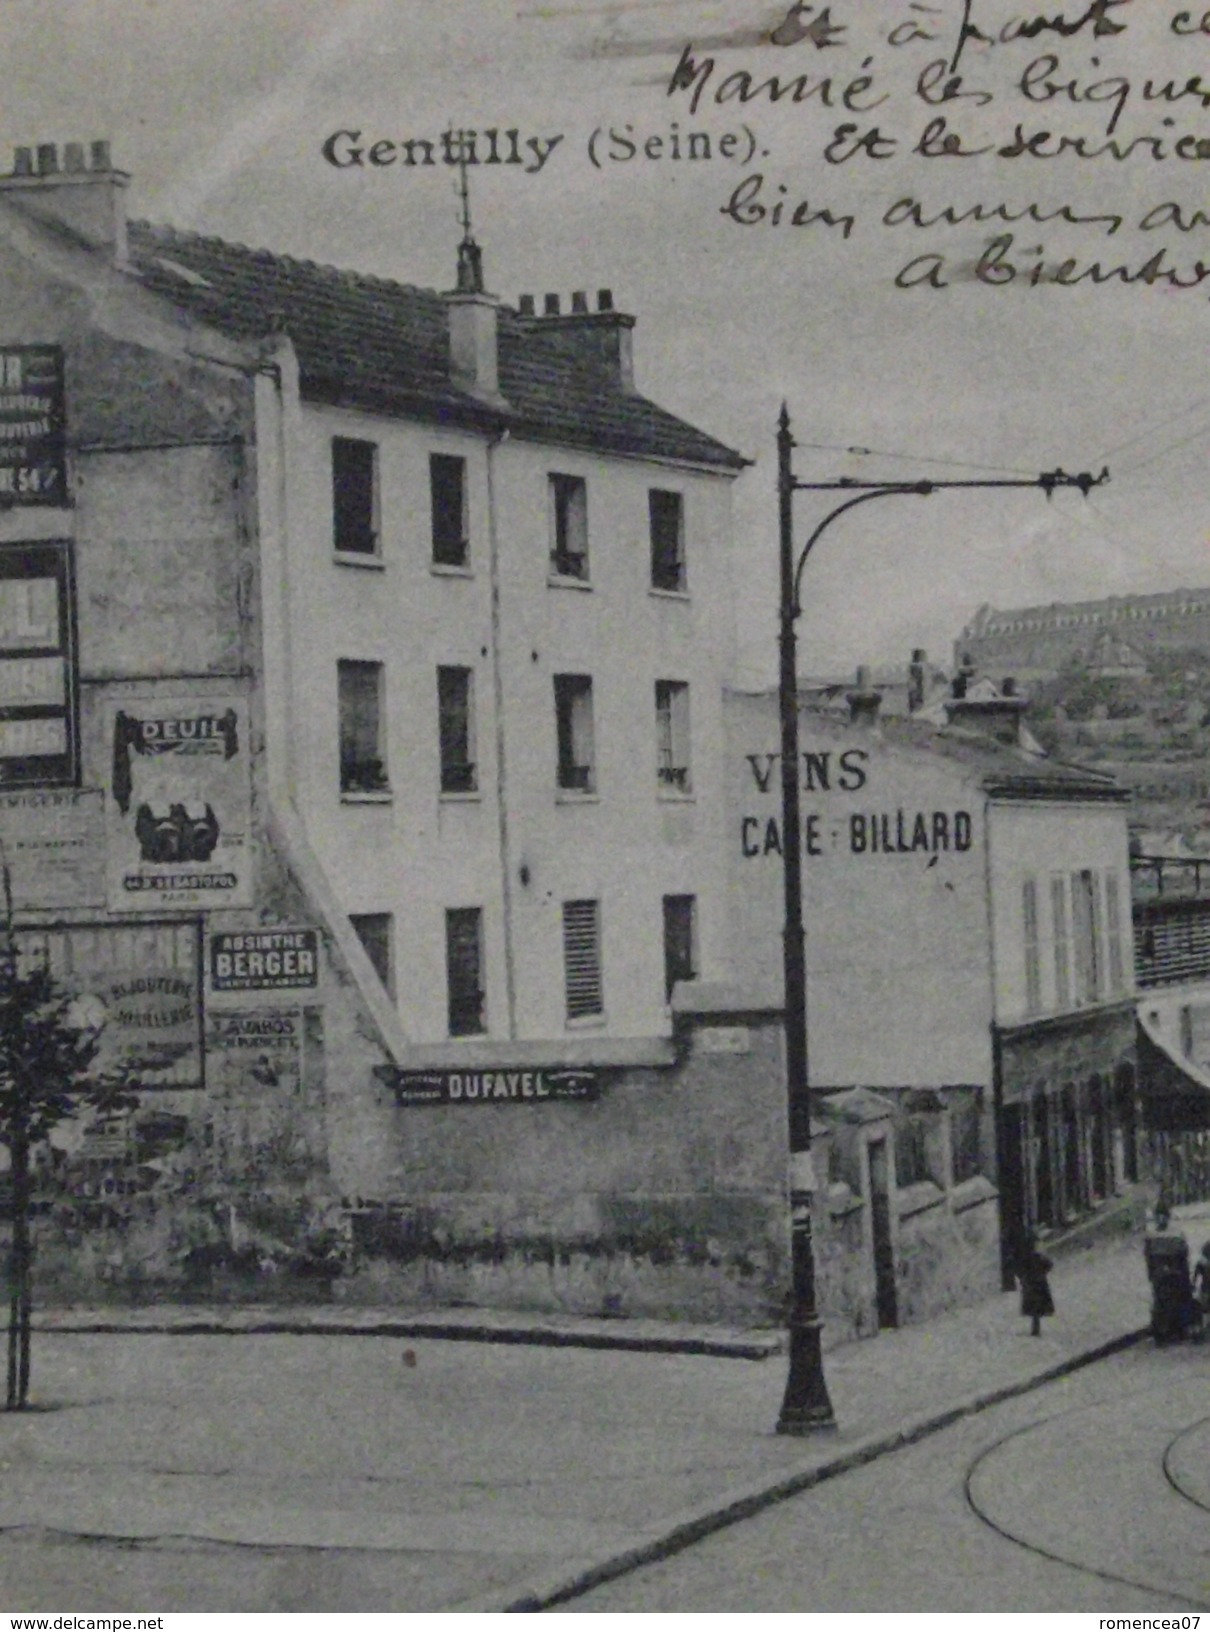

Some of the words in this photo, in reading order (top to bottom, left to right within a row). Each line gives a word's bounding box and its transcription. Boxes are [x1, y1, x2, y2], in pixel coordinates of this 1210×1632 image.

[912, 116, 995, 156] le
[142, 719, 224, 738] DEUIL
[745, 750, 869, 792] VNS
[741, 814, 822, 858] CAE
[850, 806, 972, 854] BILLARD
[217, 950, 314, 977] BERGER
[450, 1073, 549, 1098] DUFAYEL
